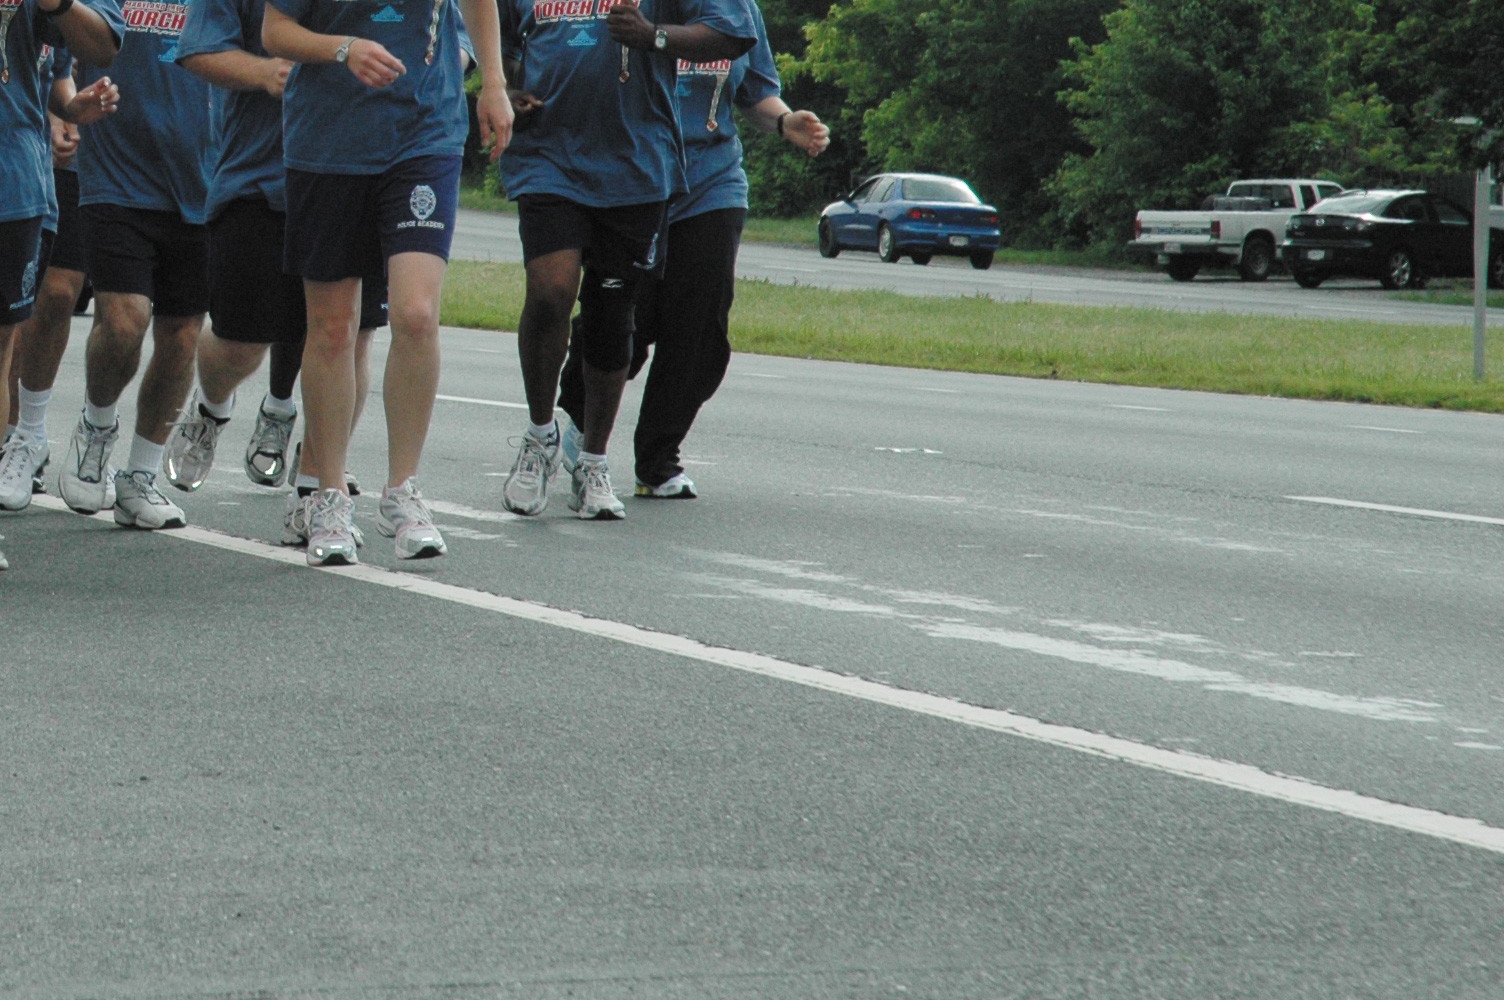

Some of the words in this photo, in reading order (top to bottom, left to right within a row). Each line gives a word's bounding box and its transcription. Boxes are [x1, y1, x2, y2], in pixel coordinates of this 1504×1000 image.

[124, 0, 166, 11] MARYLAND
[534, 0, 594, 19] TORCH
[121, 9, 187, 31] TORCH
